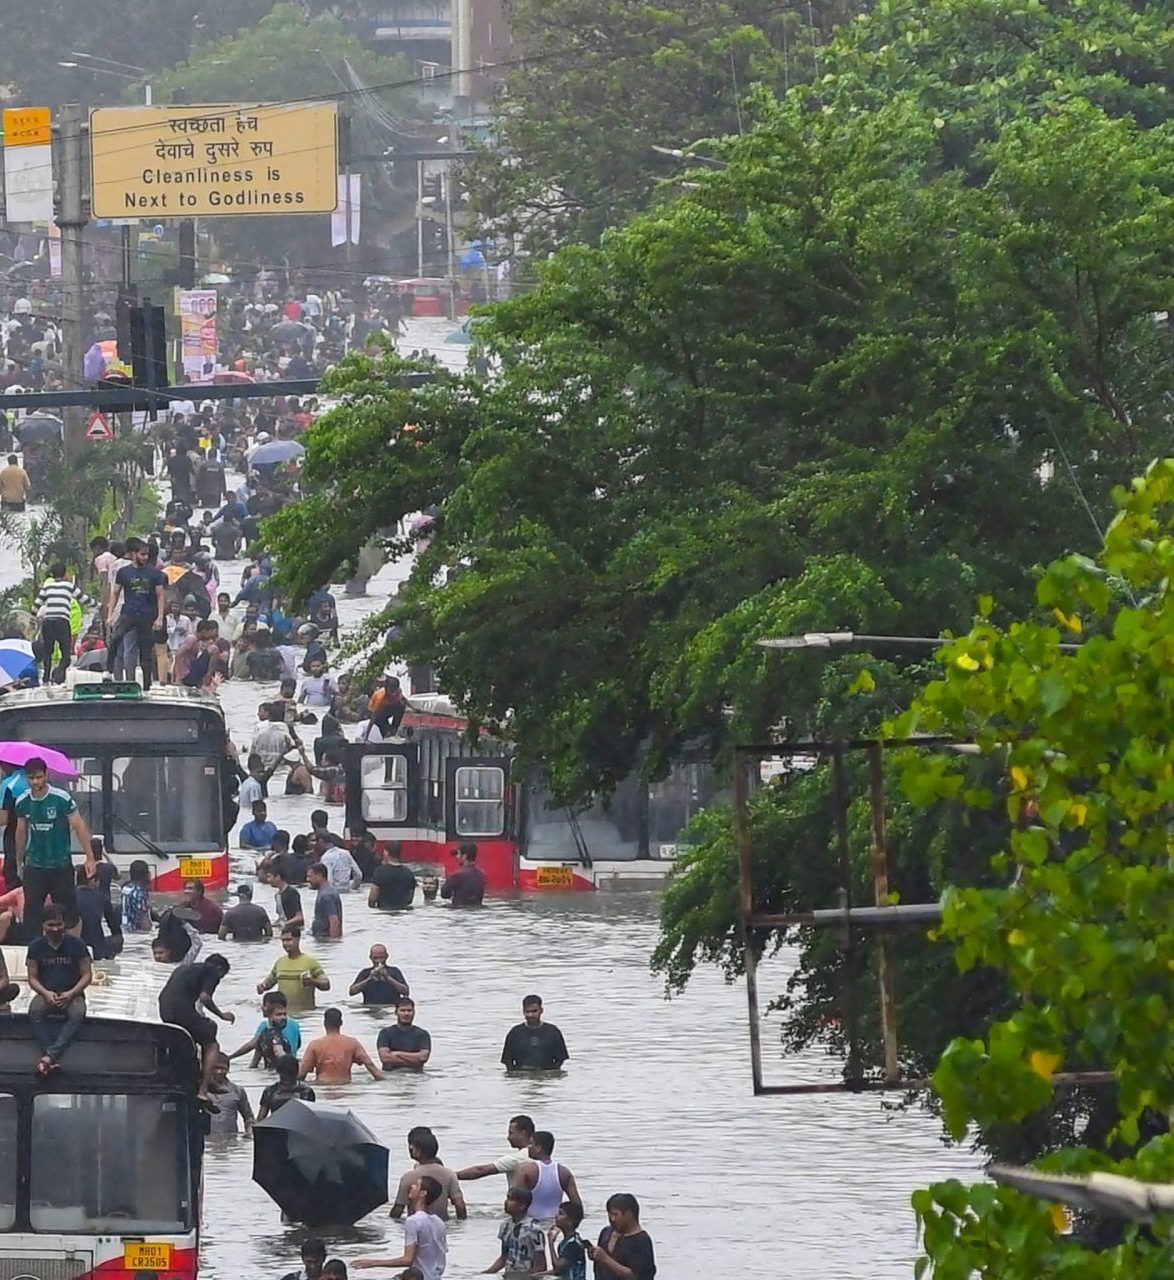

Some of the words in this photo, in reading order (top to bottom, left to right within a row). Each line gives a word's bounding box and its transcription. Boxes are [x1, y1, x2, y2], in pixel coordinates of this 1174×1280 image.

[168, 116, 225, 133] स्वच्छता
[154, 137, 194, 160] देवाचे
[205, 136, 239, 165] दुसरे
[250, 141, 273, 157] रुप
[142, 167, 253, 184] Cleanliness
[267, 165, 280, 181] is
[125, 191, 167, 208] Next
[180, 192, 197, 206] to
[209, 189, 304, 206] Godliness
[139, 1246, 162, 1257] MH01
[131, 1256, 168, 1268] CR3505
